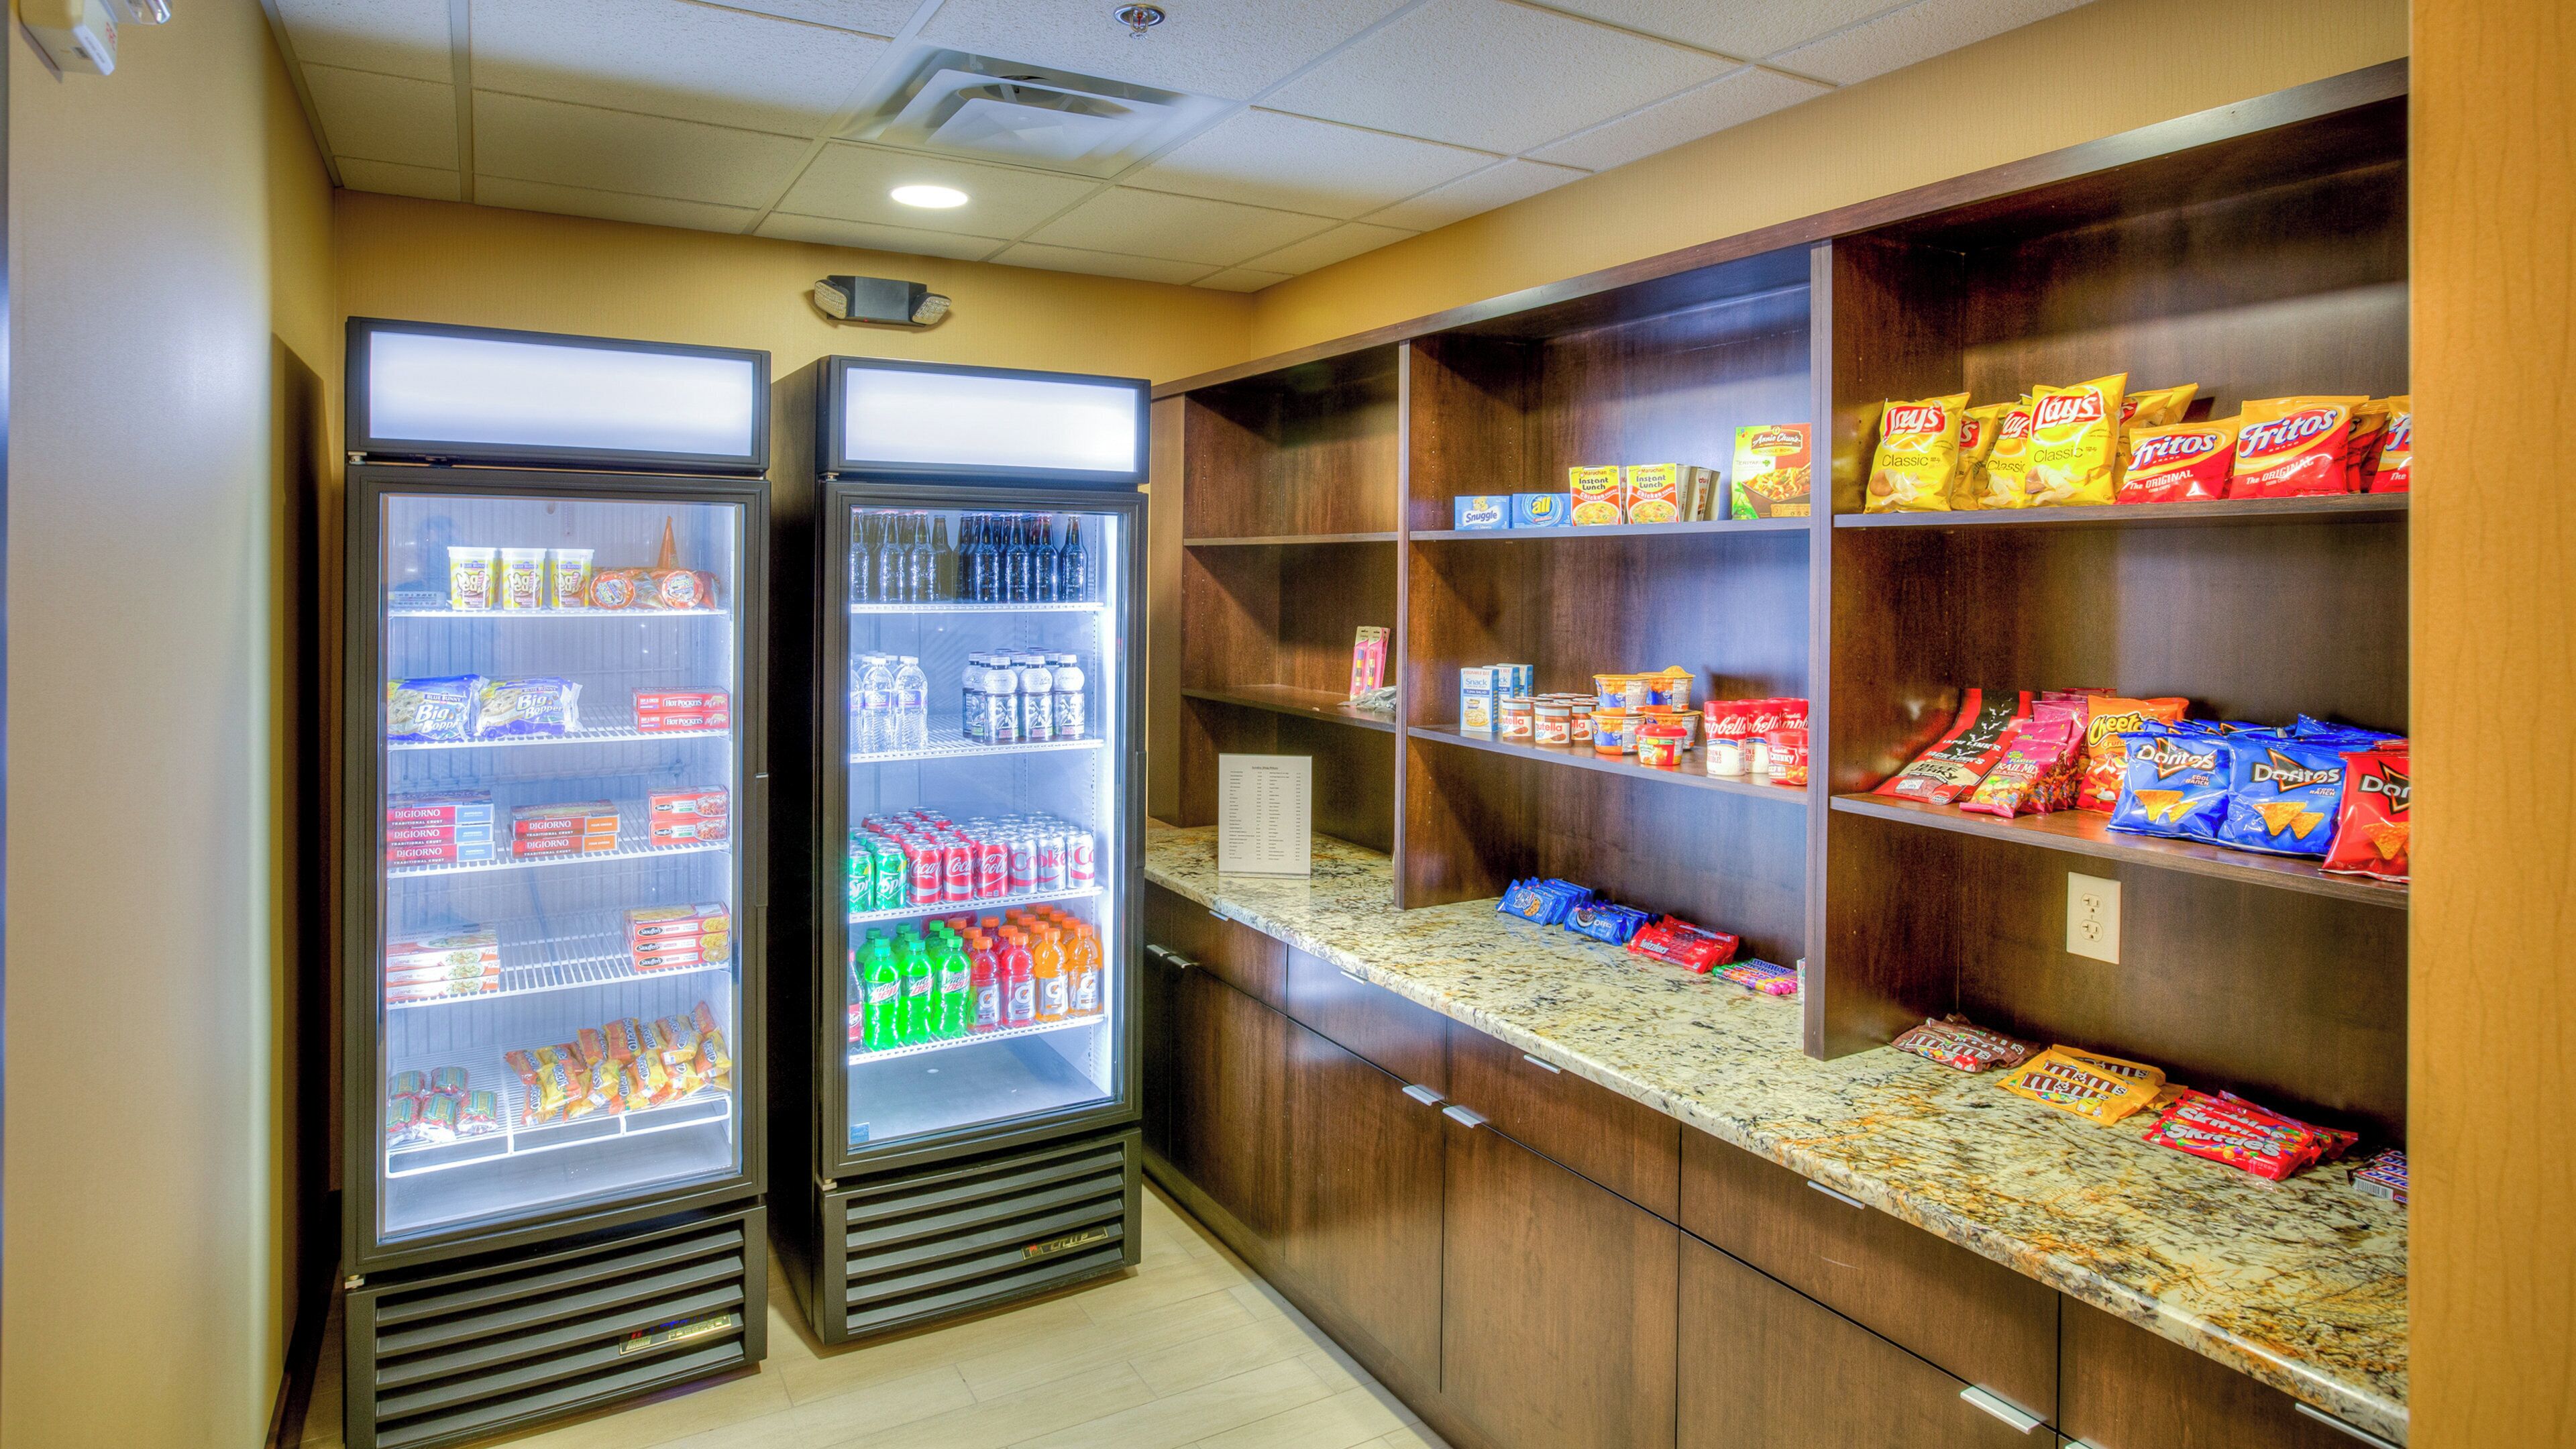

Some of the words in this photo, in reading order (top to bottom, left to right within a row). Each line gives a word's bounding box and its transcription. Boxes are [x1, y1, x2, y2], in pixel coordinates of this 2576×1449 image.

[2035, 393, 2098, 430] Lay's
[1887, 405, 1941, 434] Lay's
[2239, 409, 2337, 458] Fritos
[2034, 445, 2084, 463] Classic
[2127, 435, 2218, 471] Fritos
[1882, 454, 1929, 467] Classic
[2247, 476, 2259, 485] The
[2262, 455, 2314, 482] ORIGINAL
[2391, 472, 2406, 480] The
[1636, 474, 1666, 482] Instant
[2130, 482, 2143, 490] The
[2145, 470, 2194, 488] ORIGINAL
[1580, 491, 1605, 501] Chicken
[1637, 489, 1662, 500] Chicken
[1532, 496, 1551, 515] all
[1466, 510, 1497, 523] Snuggle
[517, 695, 547, 711] Big
[678, 699, 702, 707] POCKETS
[415, 704, 450, 722] Big
[525, 706, 563, 719] Bopper
[422, 720, 458, 733] Bopp
[1503, 716, 1524, 724] utella
[2137, 745, 2215, 769] Doritos
[2254, 763, 2343, 784] Doritos
[394, 809, 441, 818] DIGIORNO
[529, 820, 572, 829] DIGIORNO
[394, 829, 440, 839] DIGIORNO
[527, 839, 569, 849] DIGIORNO
[396, 847, 443, 857] DIGIORNO
[2166, 1124, 2281, 1157] Skittles
